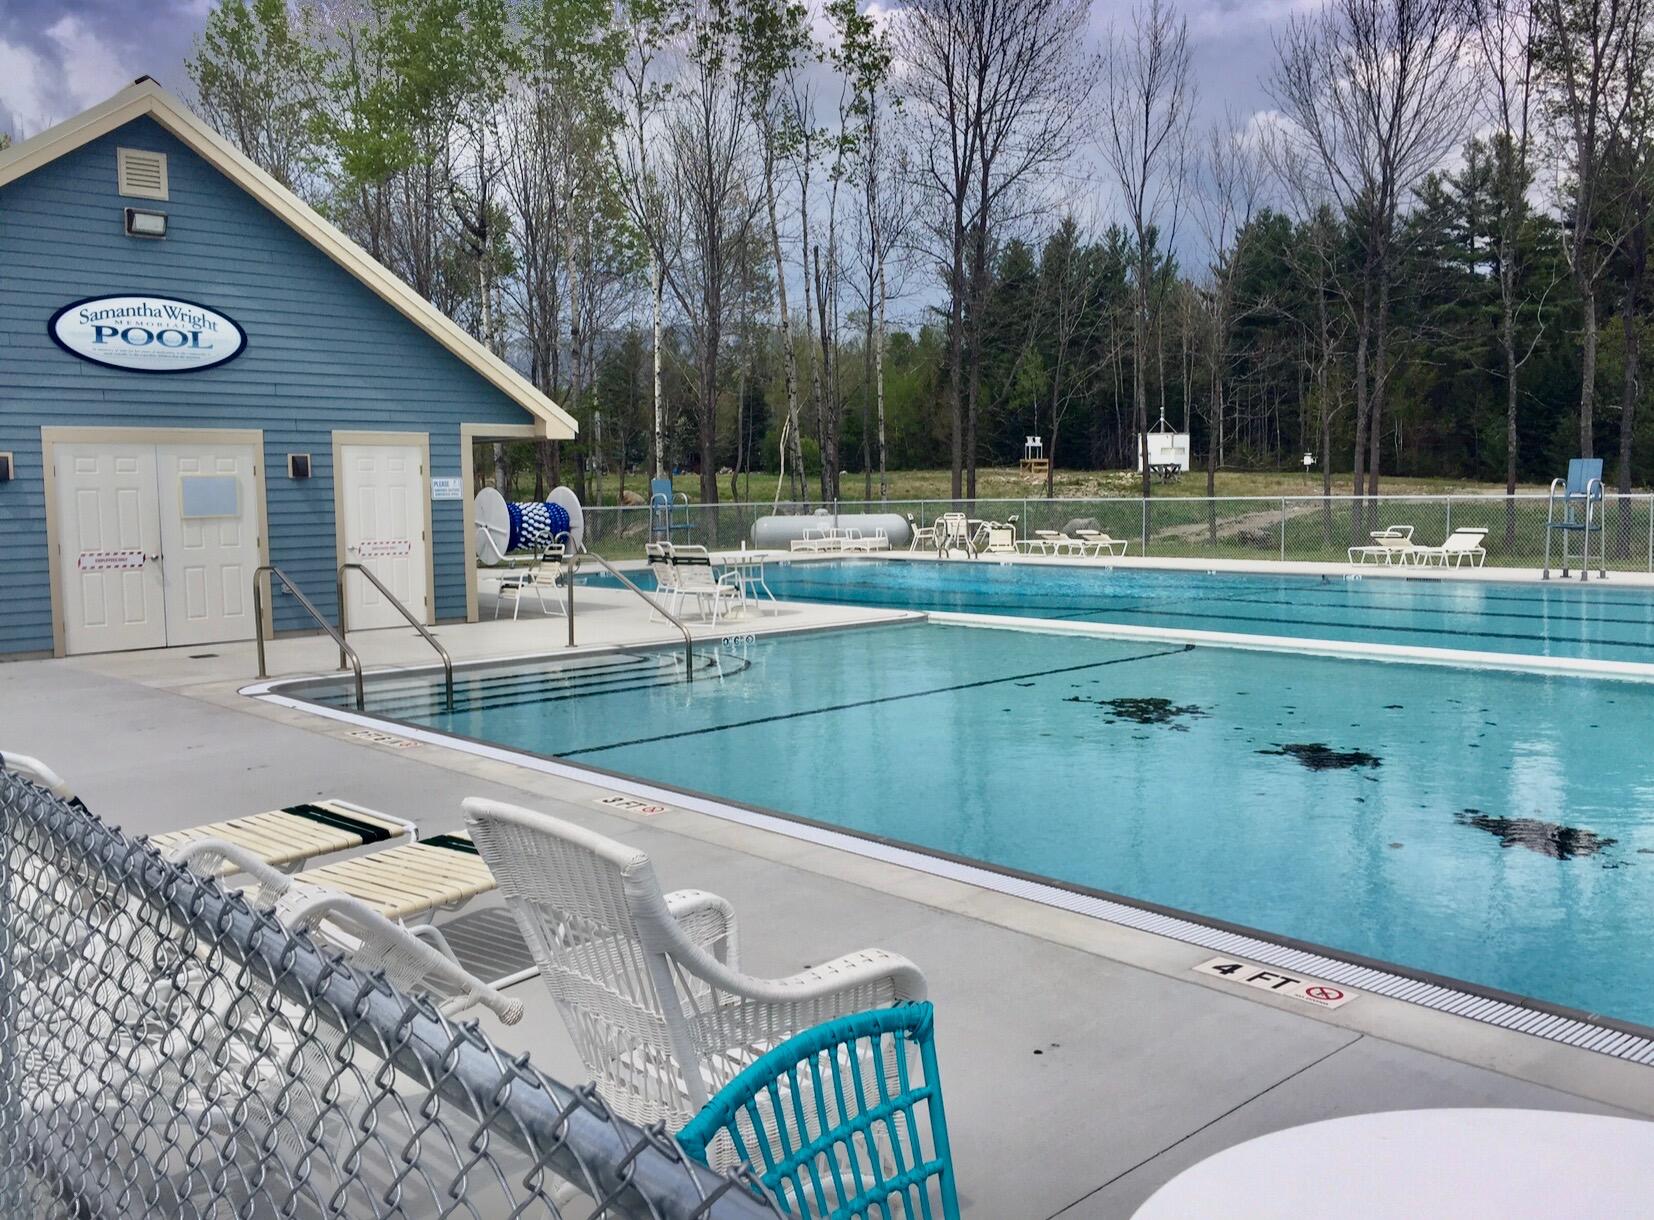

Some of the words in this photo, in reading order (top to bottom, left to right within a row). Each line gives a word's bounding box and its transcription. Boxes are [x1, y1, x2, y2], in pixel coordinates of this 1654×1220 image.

[79, 302, 162, 325] Samantha
[162, 304, 218, 332] Wright
[114, 319, 188, 328] MEMORIAL
[91, 324, 213, 349] POOL
[1212, 964, 1243, 975] 4
[1246, 971, 1301, 989] FT
